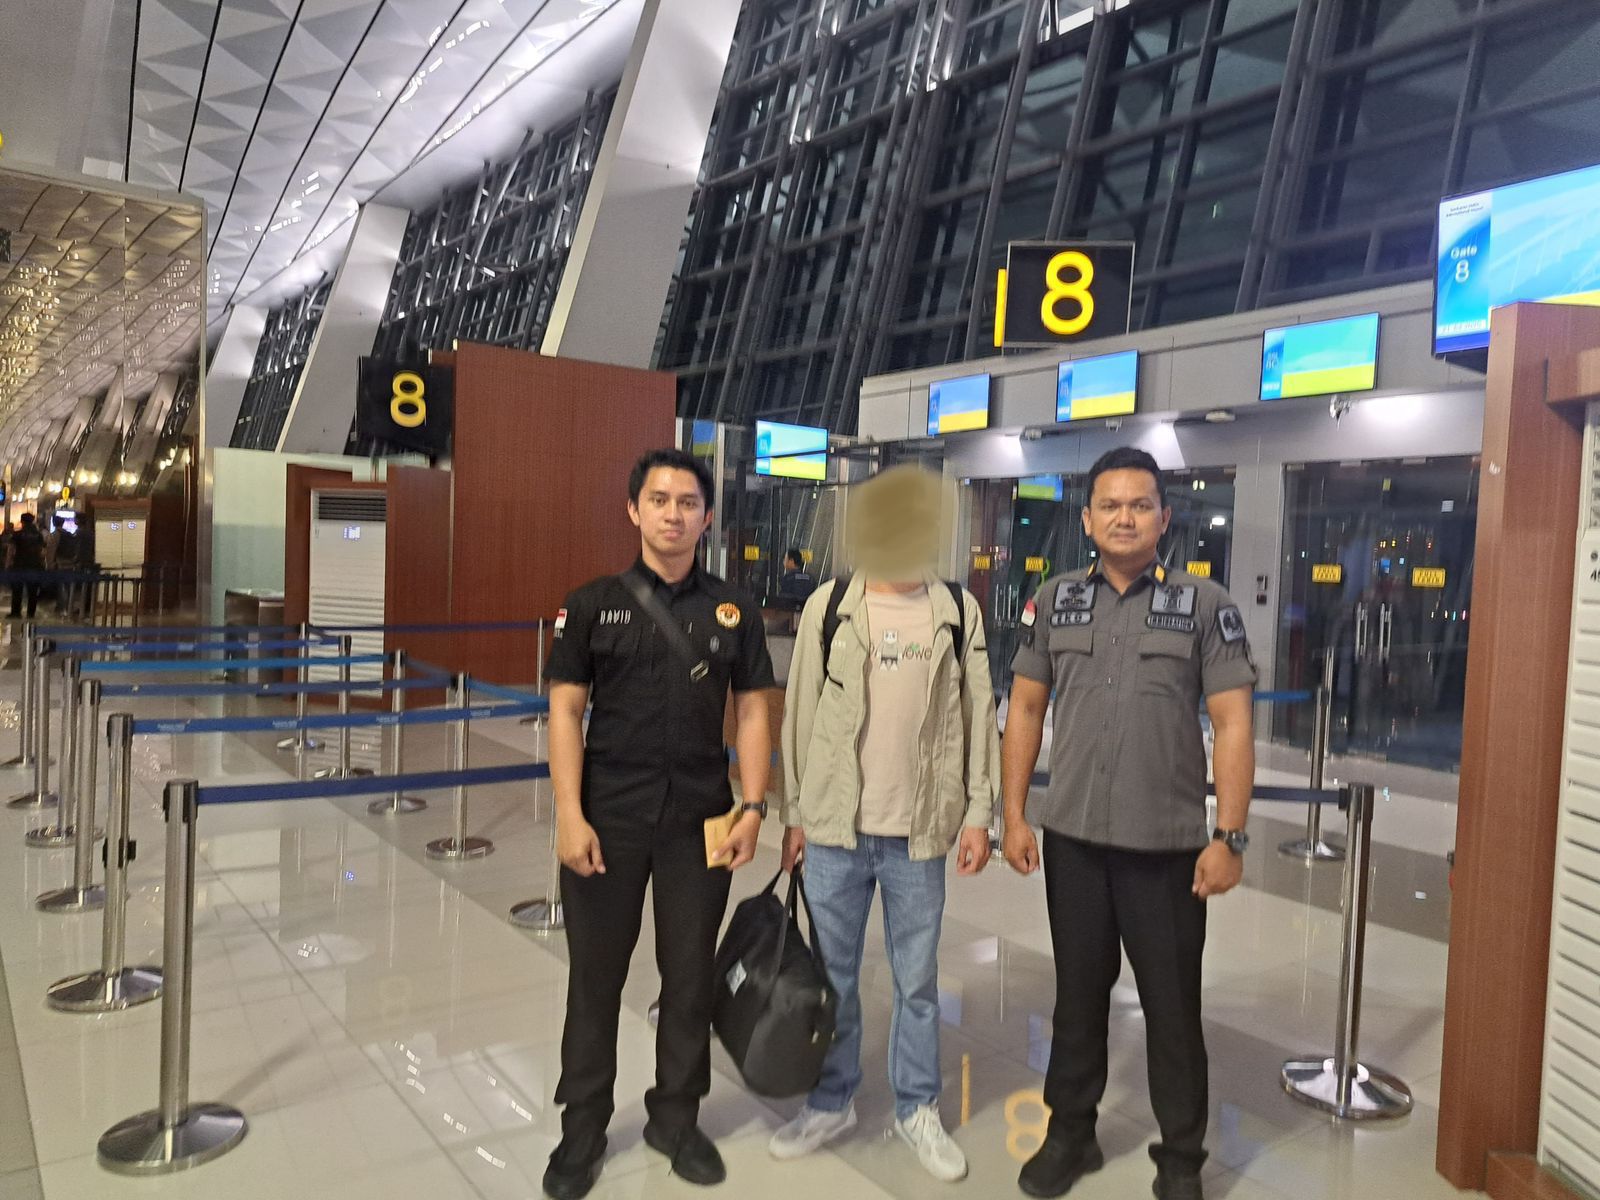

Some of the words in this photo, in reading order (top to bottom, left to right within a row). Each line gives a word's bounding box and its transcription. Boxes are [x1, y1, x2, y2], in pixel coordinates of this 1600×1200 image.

[1450, 245, 1478, 259] Gate
[1455, 259, 1470, 283] 8
[1041, 250, 1095, 335] 8
[390, 371, 427, 428] 8
[600, 609, 631, 626] DAVID
